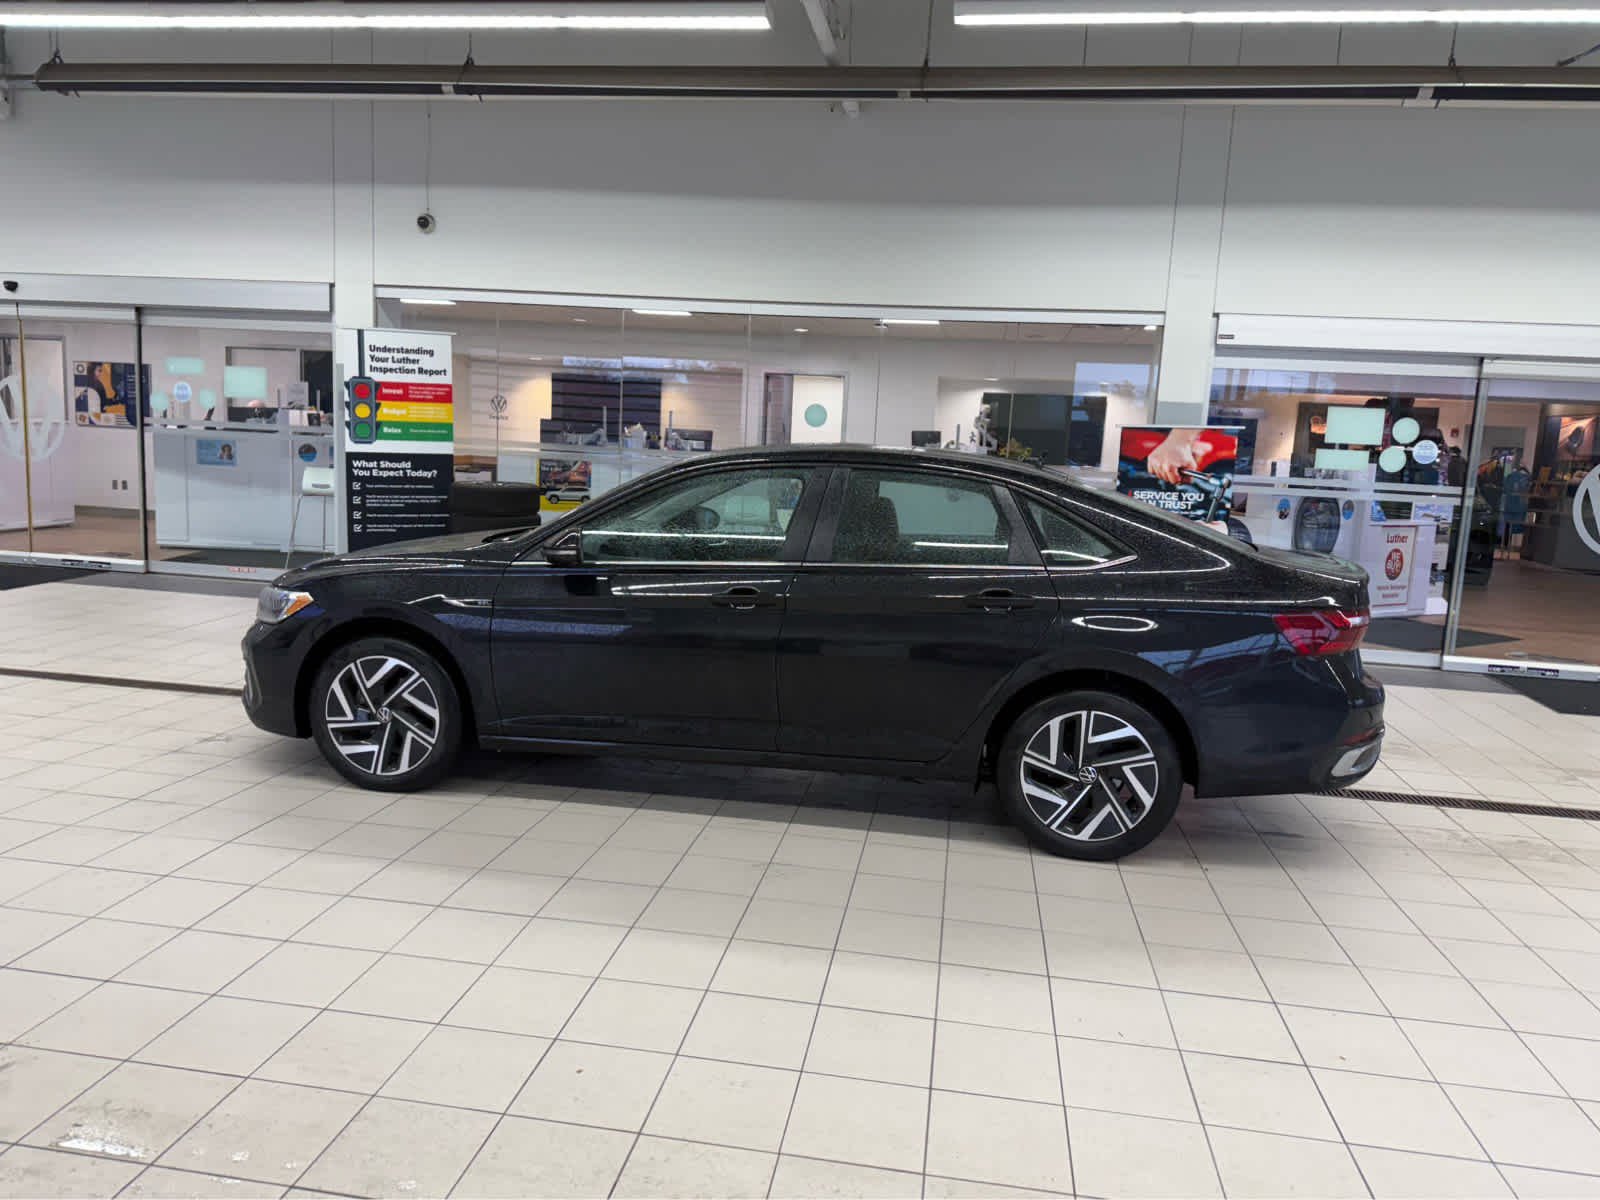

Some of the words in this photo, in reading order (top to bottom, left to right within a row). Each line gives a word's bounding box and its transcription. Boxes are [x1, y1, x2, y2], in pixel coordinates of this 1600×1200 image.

[369, 344, 434, 357] Understanding
[369, 354, 389, 363] Your
[391, 356, 420, 364] Luther
[369, 364, 416, 375] Inspection
[418, 367, 447, 376] Report
[352, 460, 377, 468] What
[380, 460, 412, 469] Should
[352, 468, 370, 477] You
[372, 469, 403, 478] Expect
[406, 470, 438, 478] Today?
[1133, 490, 1179, 501] SERVICE
[1181, 492, 1205, 502] YOU
[1158, 500, 1194, 510] TRUST
